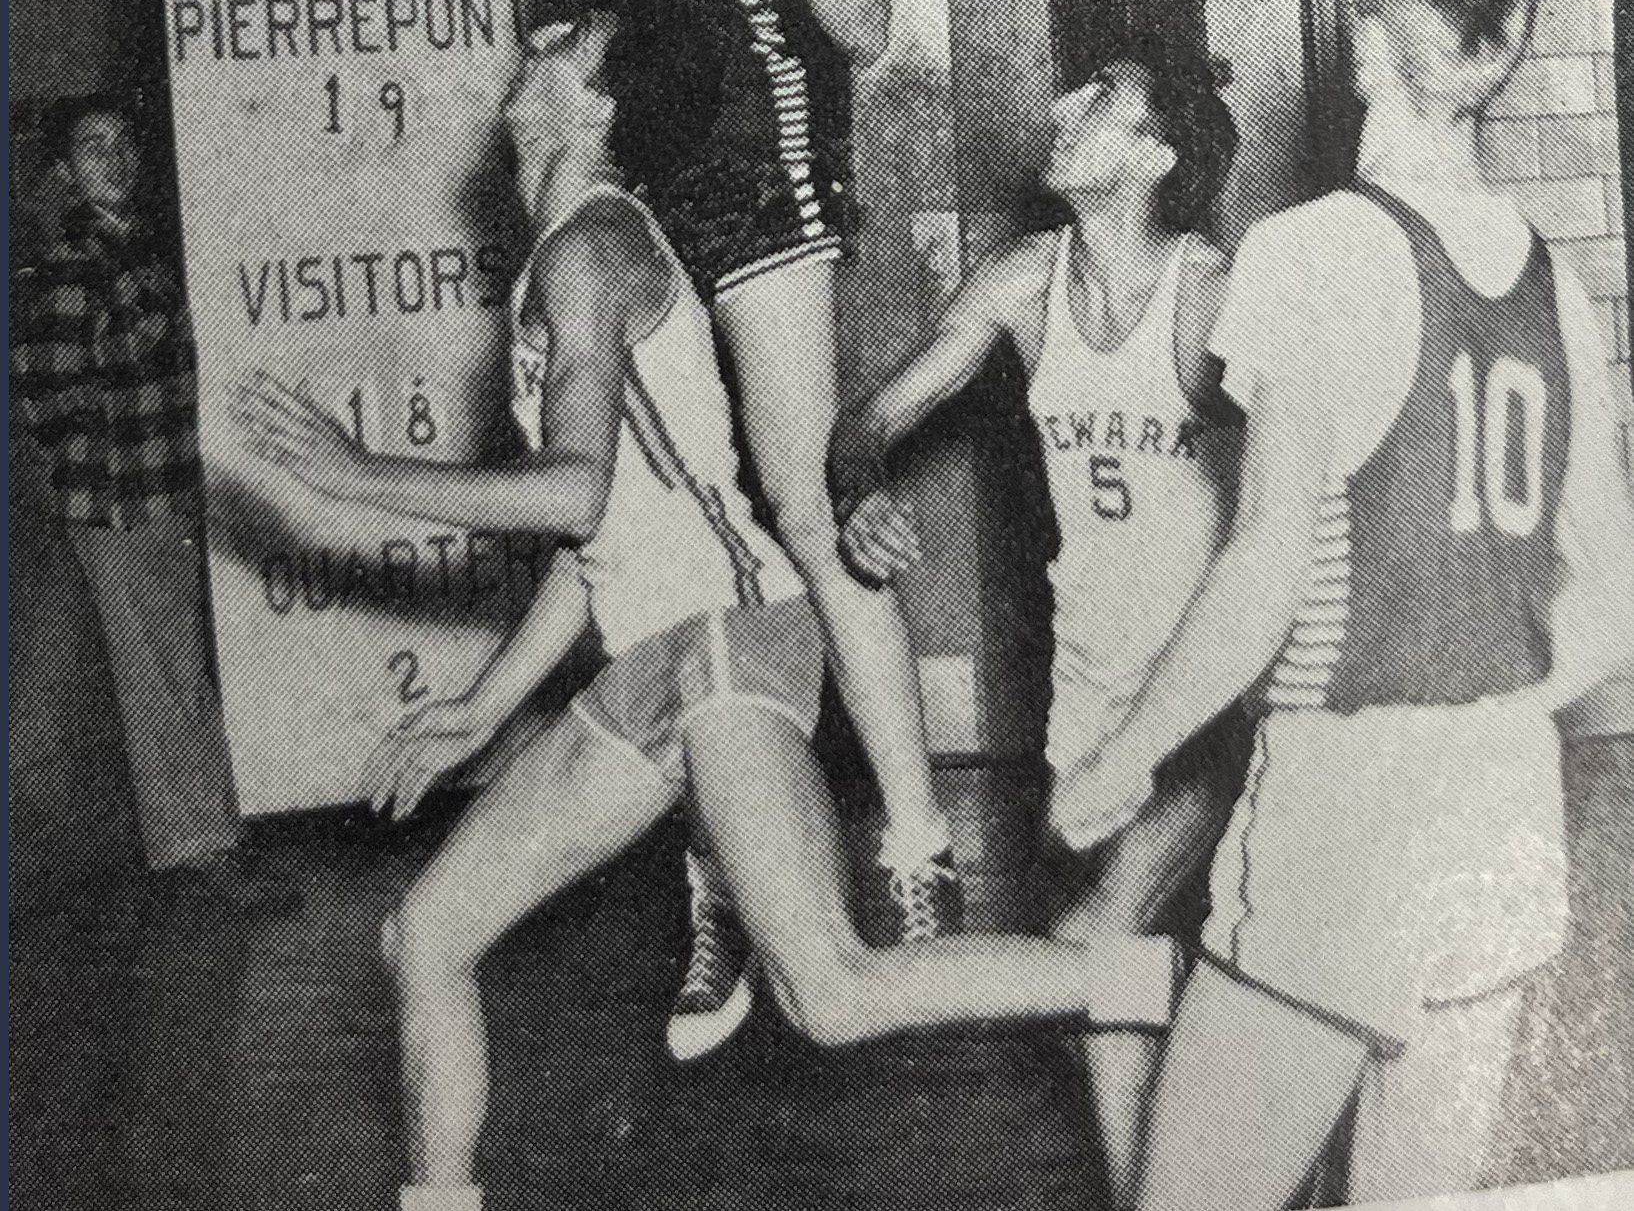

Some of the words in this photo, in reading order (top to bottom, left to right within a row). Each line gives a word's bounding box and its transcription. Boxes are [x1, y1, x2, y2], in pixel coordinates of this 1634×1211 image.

[237, 246, 510, 327] VISITORS
[1448, 346, 1549, 538] 10
[1088, 452, 1134, 523] 5
[385, 650, 429, 704] 2
